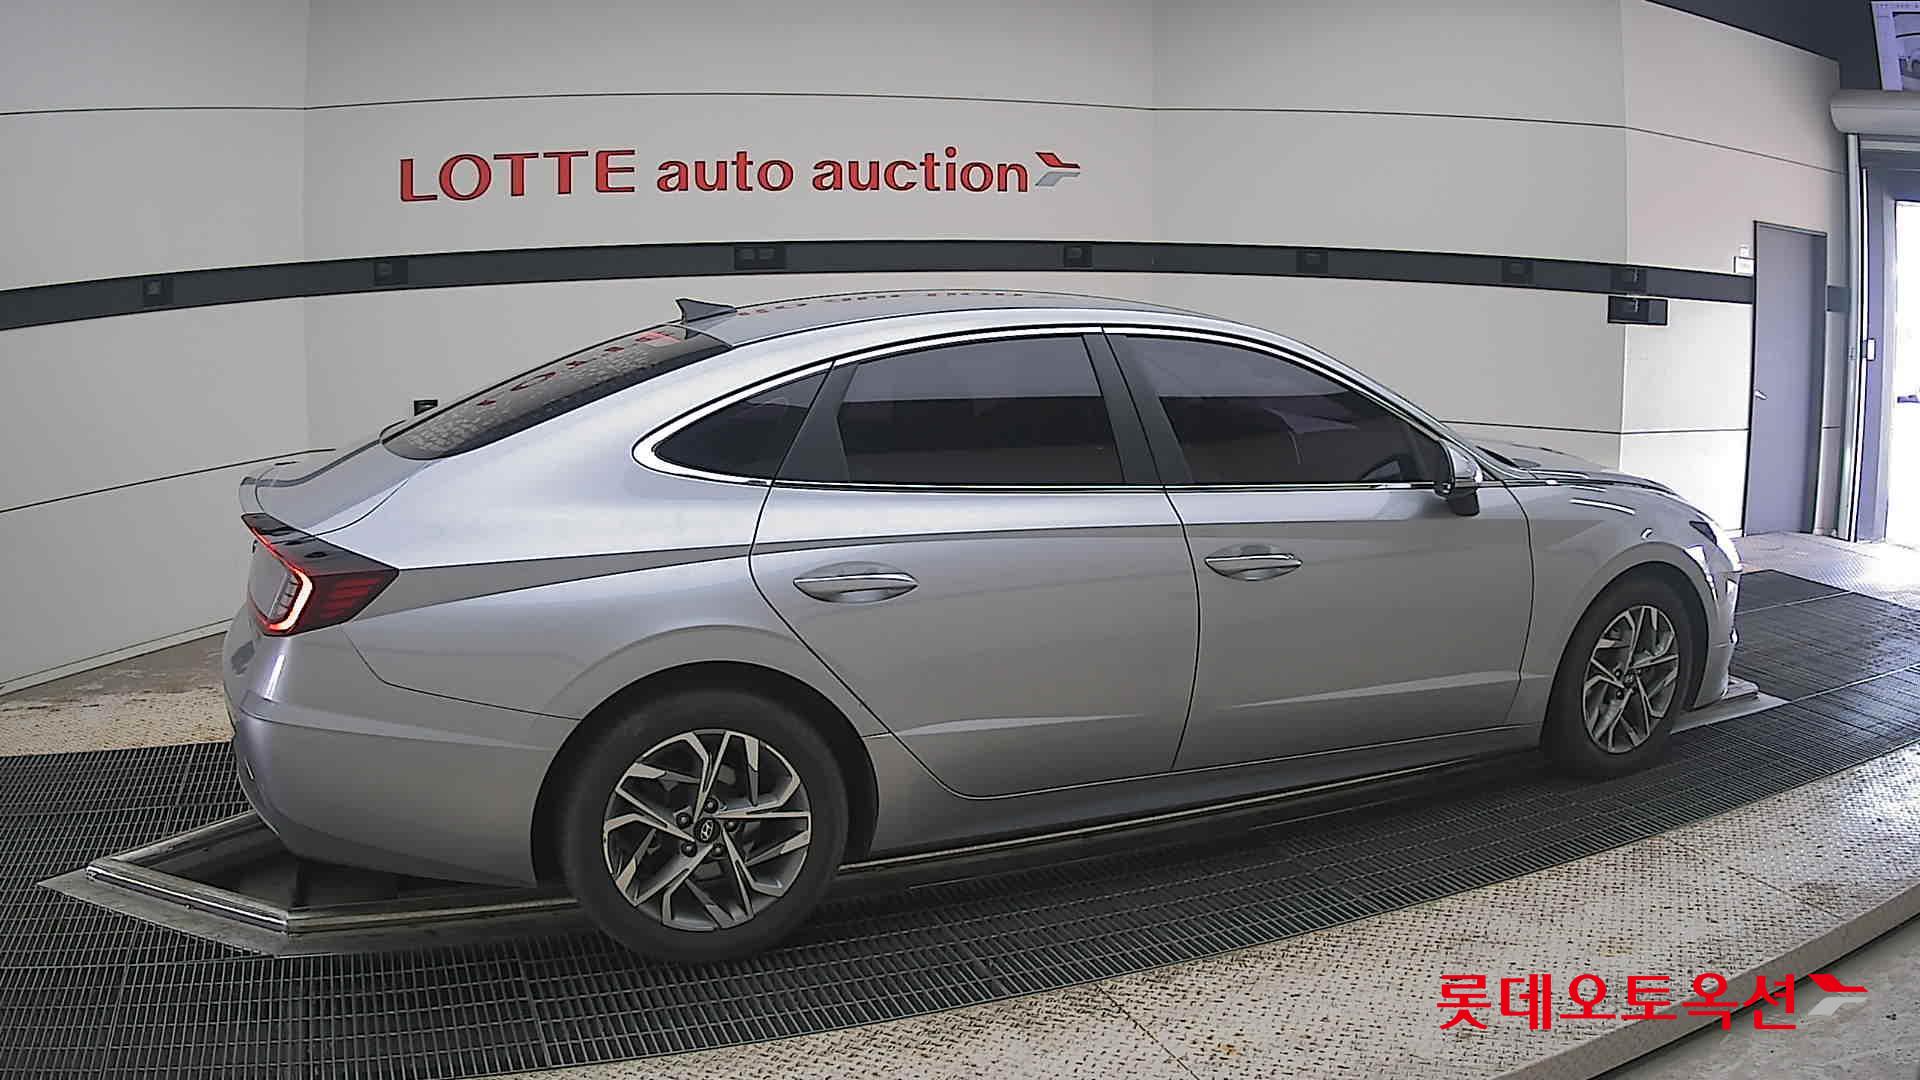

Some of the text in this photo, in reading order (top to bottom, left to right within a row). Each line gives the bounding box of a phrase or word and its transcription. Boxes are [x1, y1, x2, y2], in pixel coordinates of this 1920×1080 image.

[400, 146, 1029, 202] LOTTE auto auction
